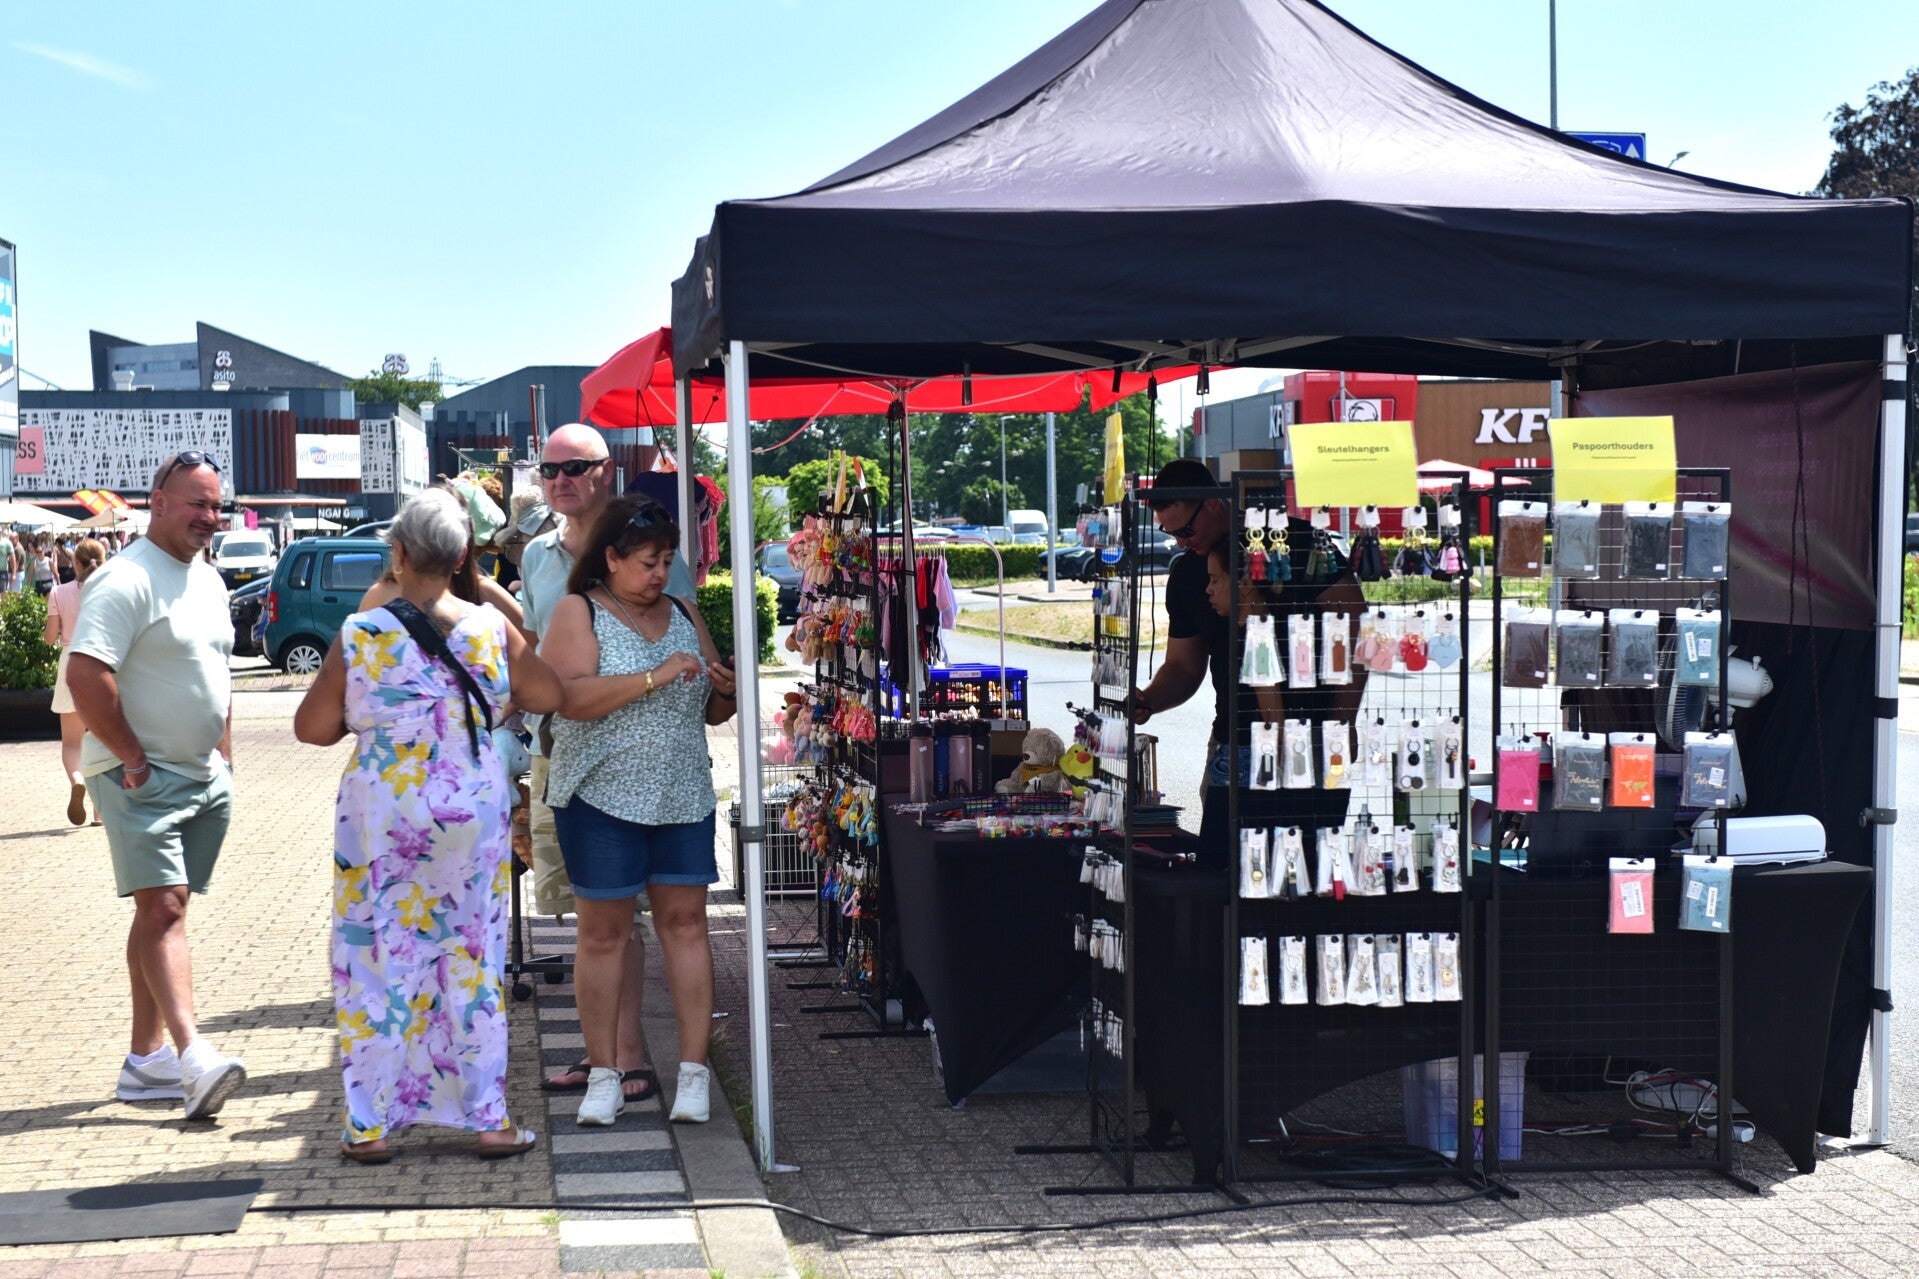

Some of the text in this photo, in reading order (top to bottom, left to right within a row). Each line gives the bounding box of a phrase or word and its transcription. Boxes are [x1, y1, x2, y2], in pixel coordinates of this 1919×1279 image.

[213, 368, 236, 382] asito
[1269, 404, 1285, 440] KF
[1474, 407, 1552, 444] KF
[16, 441, 37, 459] SS
[1317, 445, 1390, 455] Sleutelhangers
[1572, 442, 1654, 451] Paspoorthouders
[318, 508, 350, 519] NGANG
